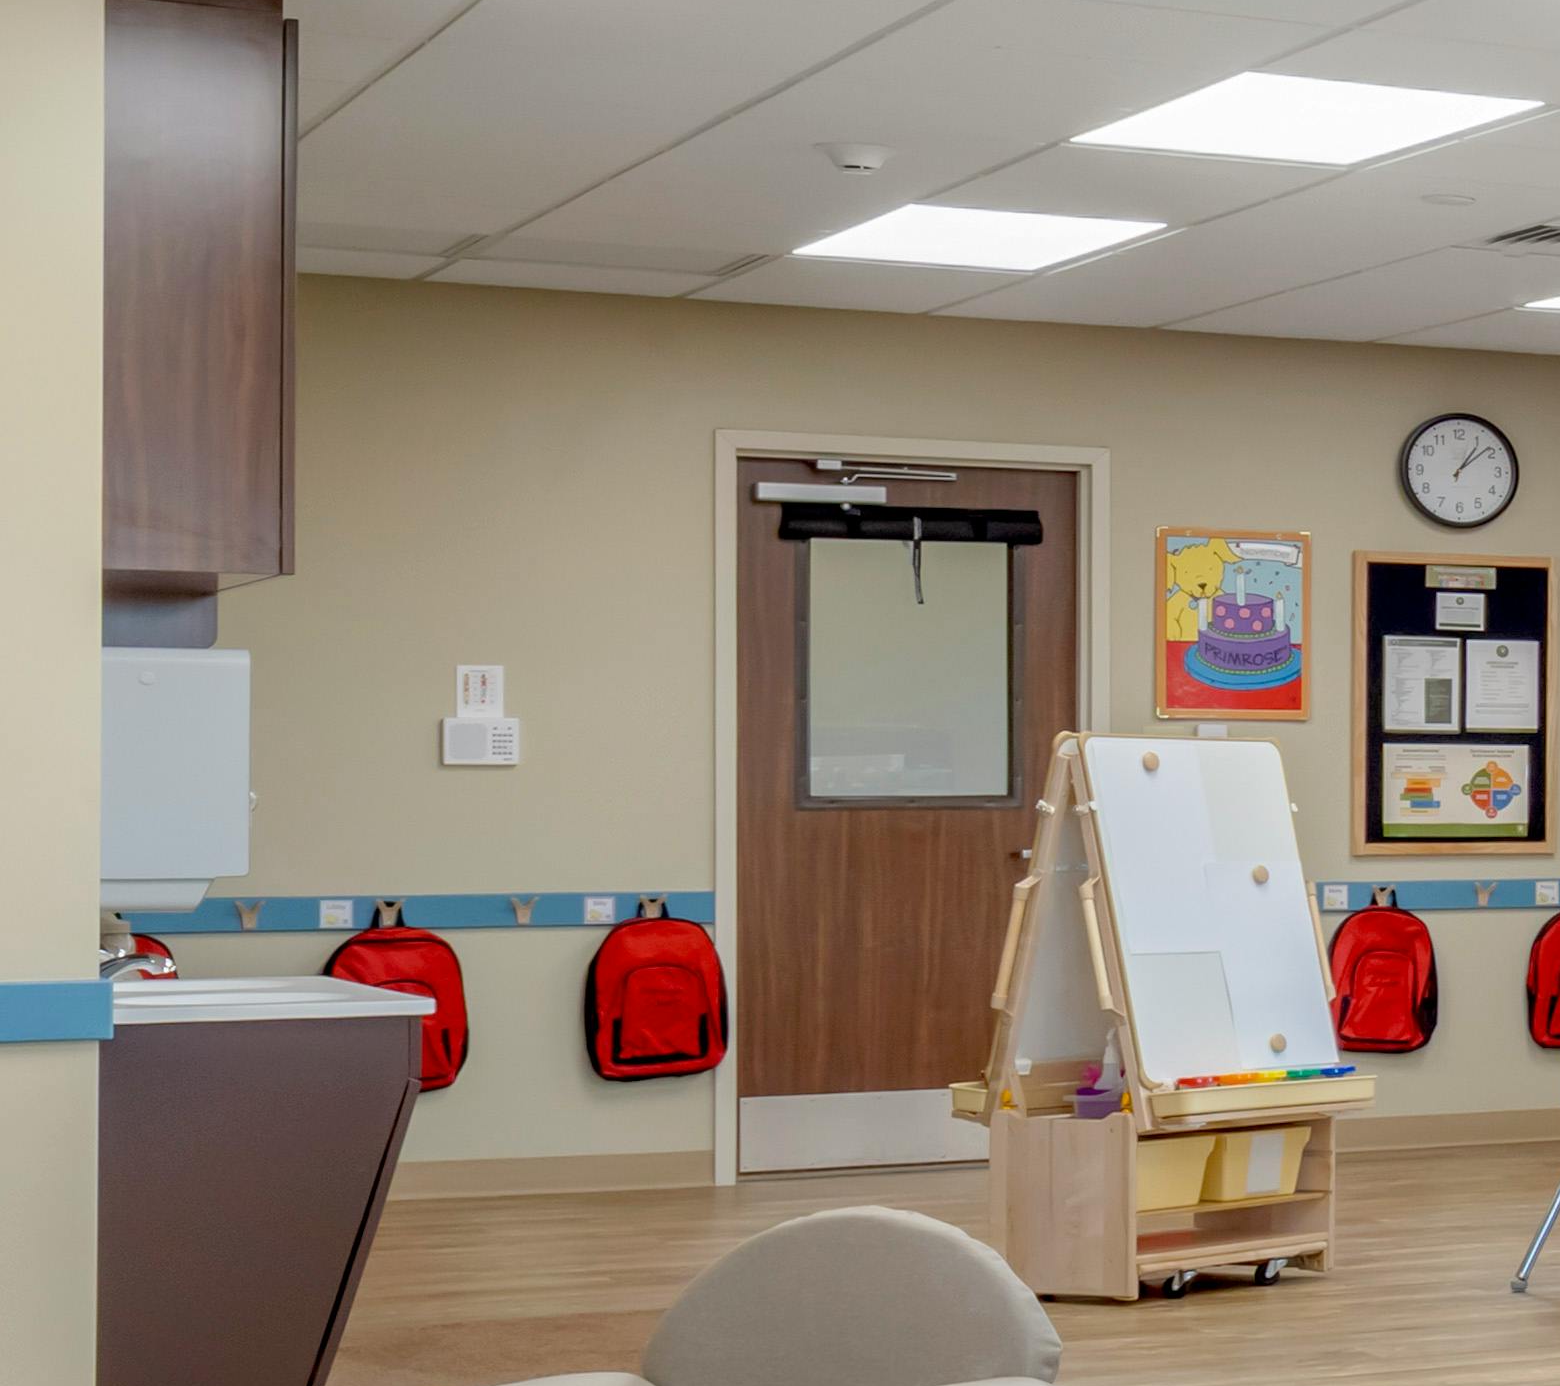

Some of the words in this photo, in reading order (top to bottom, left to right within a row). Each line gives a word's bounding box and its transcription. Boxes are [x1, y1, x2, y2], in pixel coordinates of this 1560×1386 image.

[1434, 434, 1445, 446] 11
[1453, 428, 1466, 441] 12
[1422, 444, 1435, 457] 10
[1487, 446, 1496, 459] 2
[1415, 463, 1424, 476] 9
[1494, 466, 1502, 479] 3
[1421, 481, 1431, 494] 8
[1488, 484, 1496, 495] 4
[1437, 496, 1446, 508] 7
[1455, 501, 1464, 514] 6
[1474, 497, 1482, 509] 5
